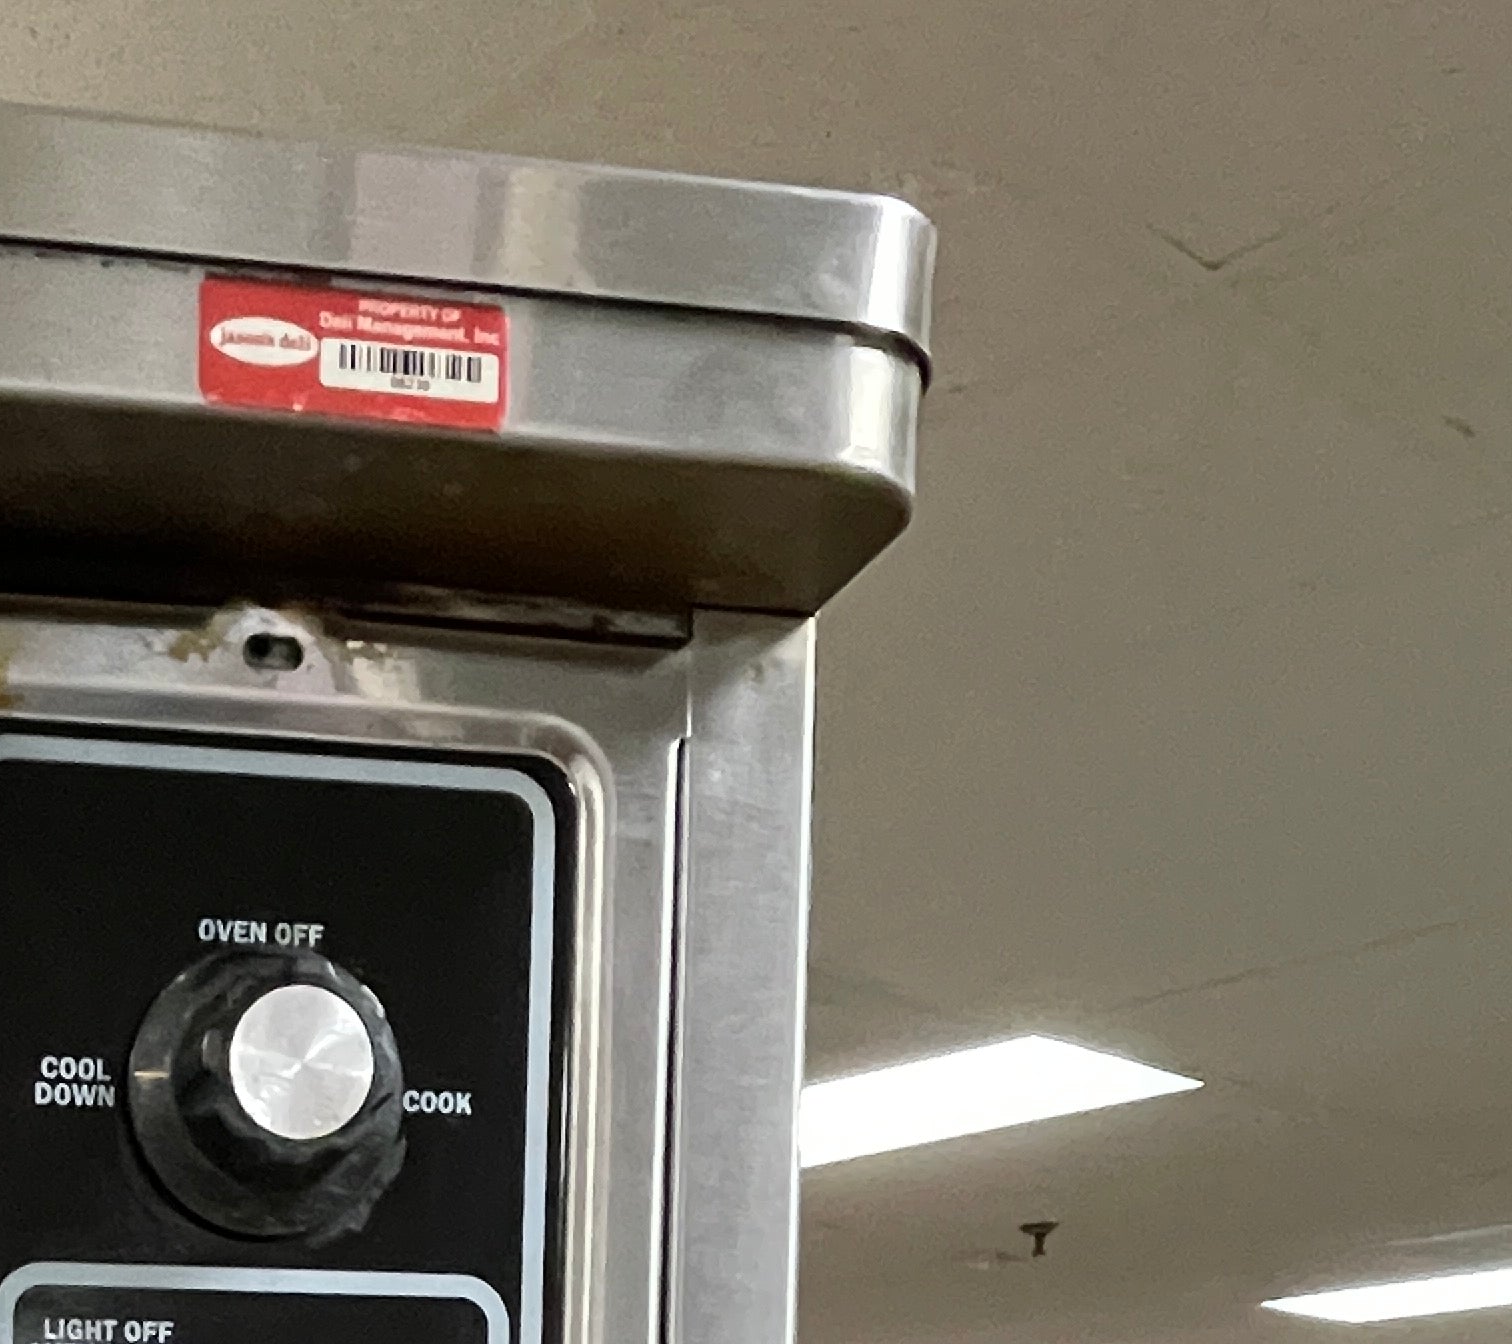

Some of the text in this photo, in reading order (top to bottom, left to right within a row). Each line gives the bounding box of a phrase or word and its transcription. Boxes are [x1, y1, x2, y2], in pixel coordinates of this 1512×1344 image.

[198, 919, 325, 948] OVEN OFF
[40, 1056, 112, 1081] COOL
[34, 1083, 116, 1108] DOWN
[403, 1090, 473, 1116] COOK
[43, 1318, 175, 1343] LIGHT OFF
